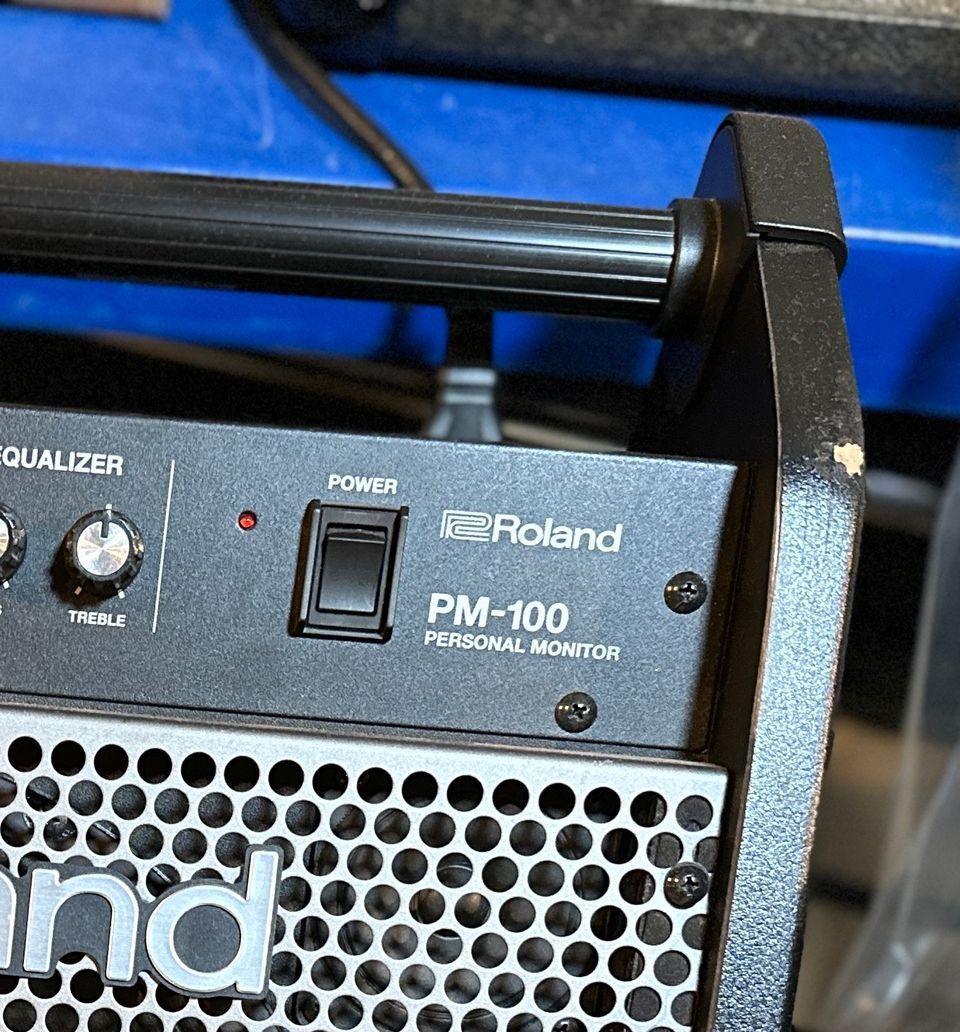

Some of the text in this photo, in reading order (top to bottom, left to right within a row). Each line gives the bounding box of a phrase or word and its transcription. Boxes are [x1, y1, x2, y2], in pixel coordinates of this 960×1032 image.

[328, 474, 398, 495] POWER
[492, 514, 623, 553] Roland
[68, 609, 127, 628] TREBLE
[427, 593, 570, 635] PM-100
[424, 631, 621, 662] PERSONAL MONITOR
